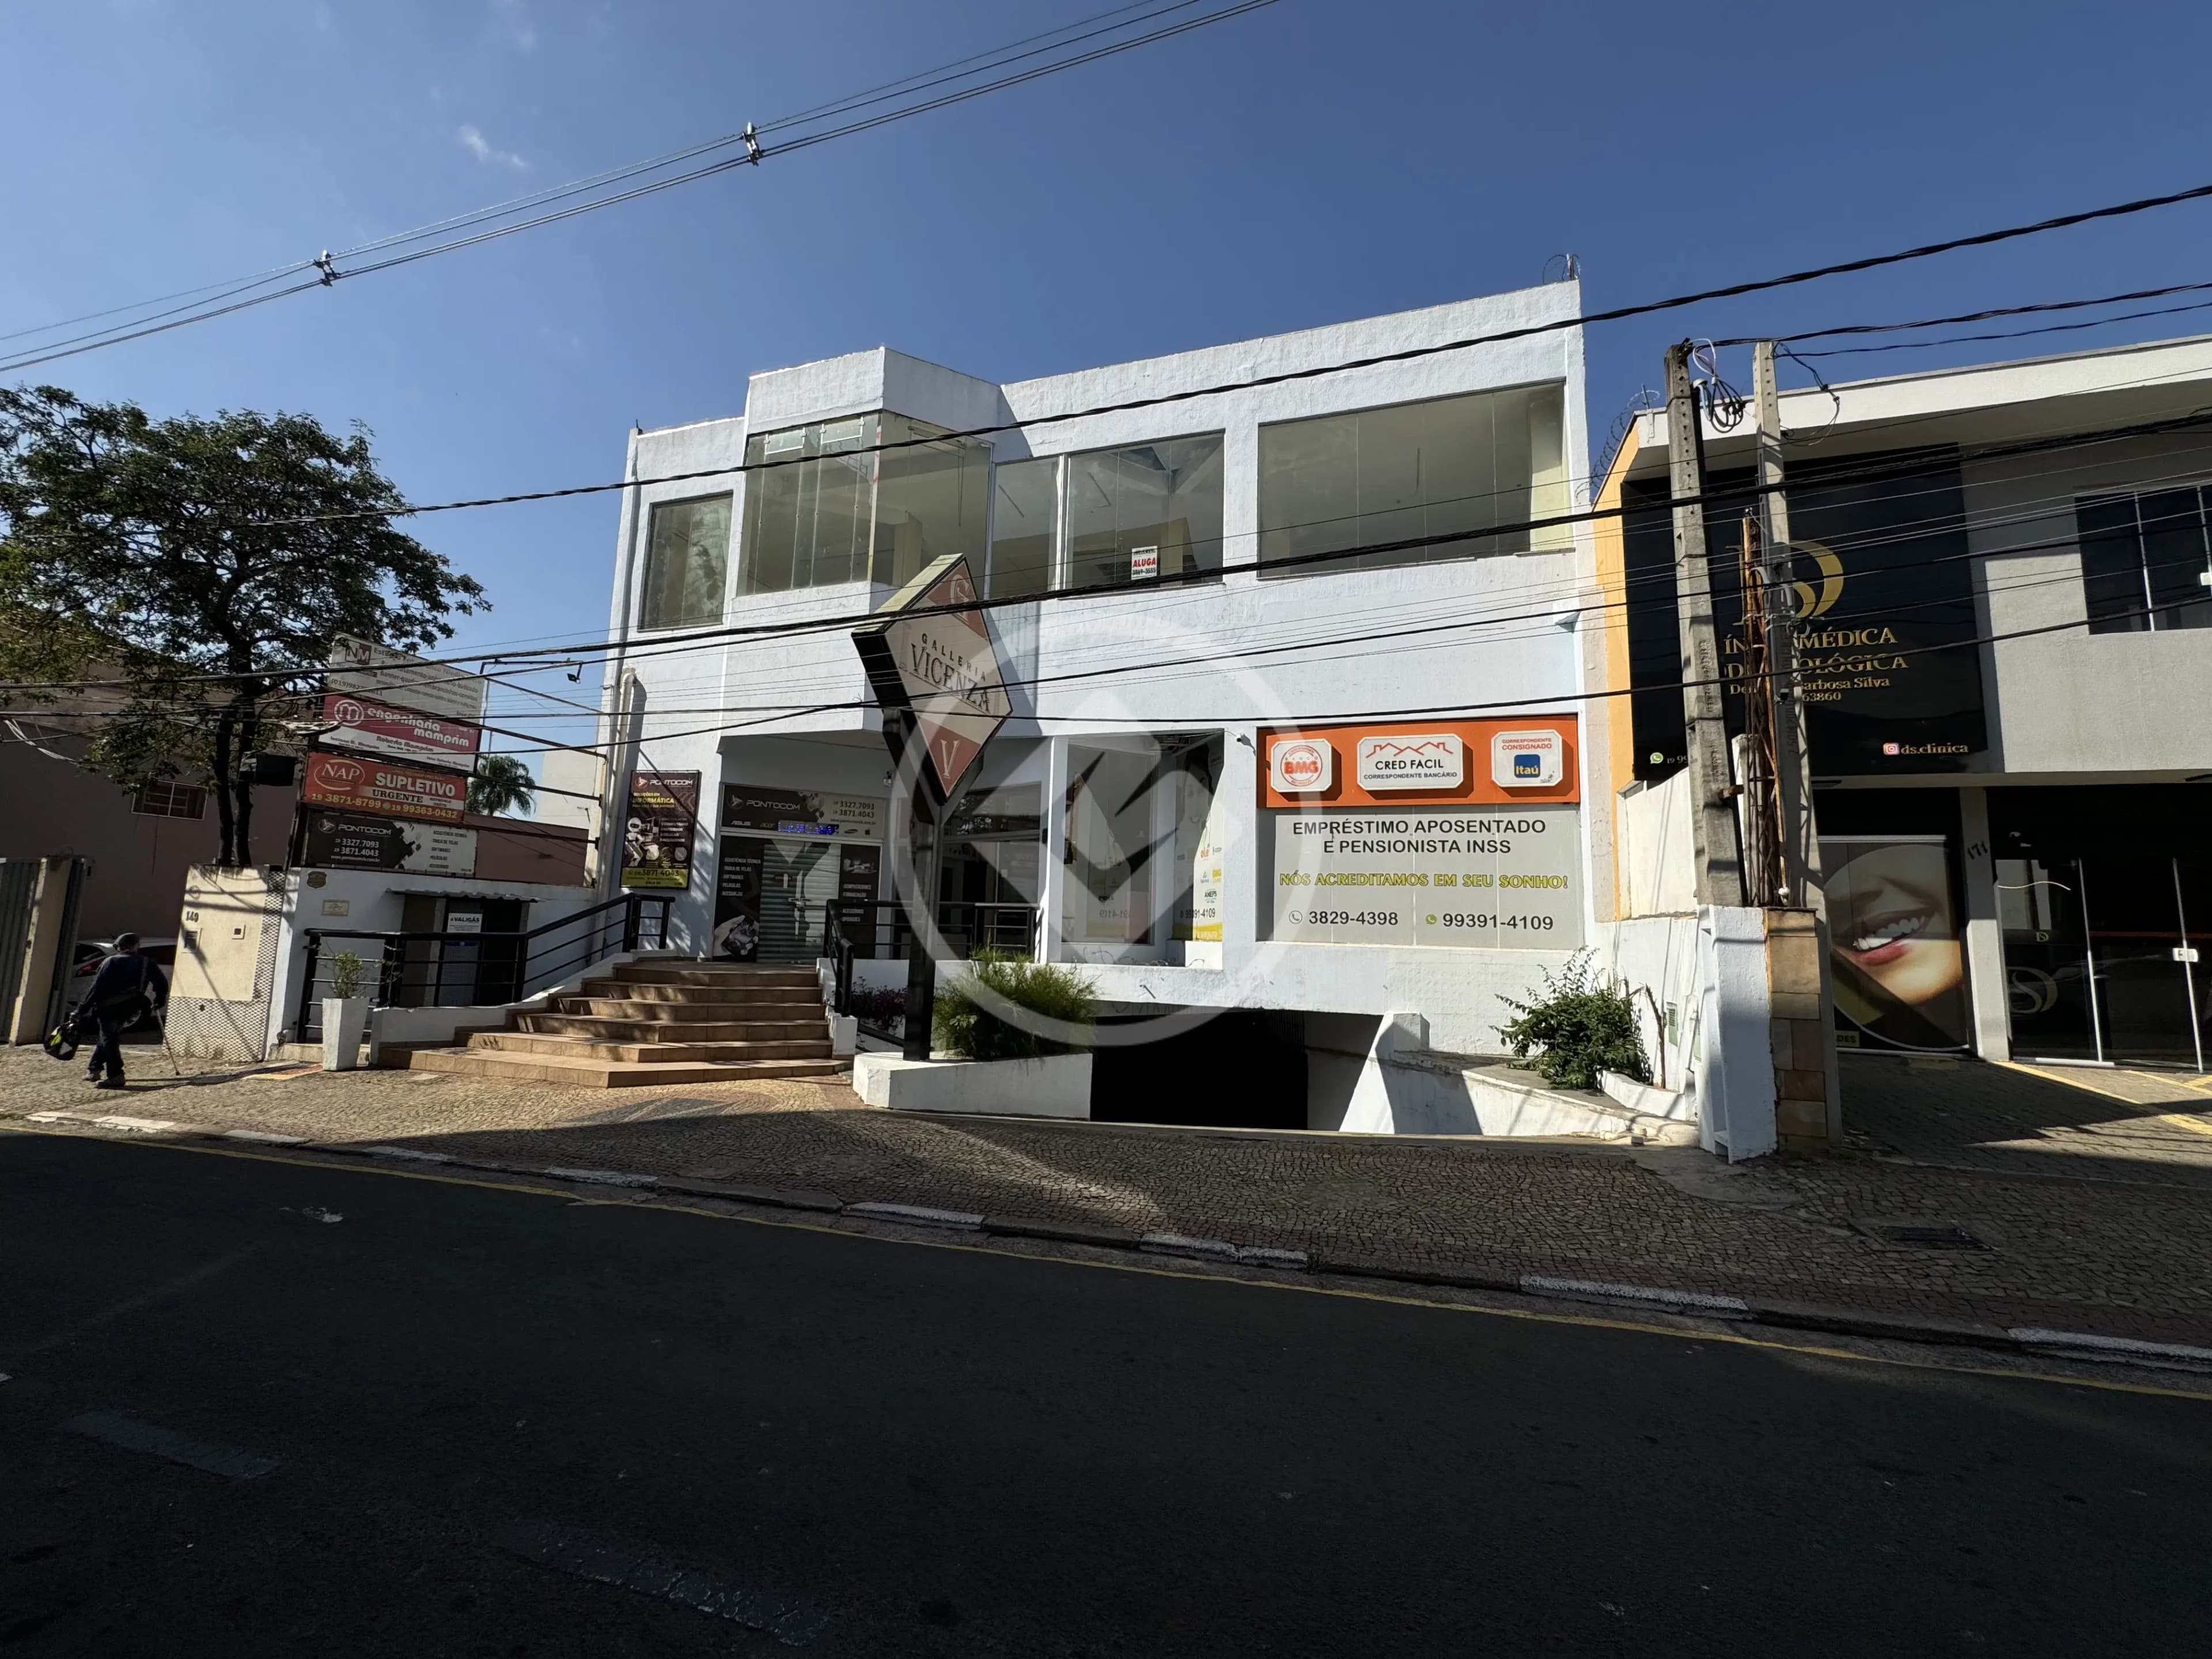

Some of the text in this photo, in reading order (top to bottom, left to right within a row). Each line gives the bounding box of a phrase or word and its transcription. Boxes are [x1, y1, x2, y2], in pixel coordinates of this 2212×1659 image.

[1133, 558, 1156, 567] ALUGA
[1799, 627, 1898, 649] MÉDICA
[922, 633, 986, 682] GALLERIA
[911, 643, 991, 714] VICENZA
[1854, 676, 1890, 688] Silva
[368, 708, 440, 731] engenharia
[414, 727, 469, 747] mamprim
[1901, 743, 1968, 754] ds.clinica
[940, 739, 960, 779] V
[1375, 759, 1444, 770] CRED FACIL
[321, 764, 360, 780] NAP
[1285, 761, 1318, 774] BMG
[1516, 764, 1539, 774] Itaú
[376, 772, 455, 797] SUPLETIVO
[372, 789, 423, 803] URGENTE
[325, 794, 381, 808] 3871-8799
[403, 804, 457, 819] 99363-0432
[746, 800, 800, 810] PONTOCOM
[840, 801, 874, 810] 3327.7093
[839, 809, 874, 818] 3871.4043
[338, 824, 392, 835] PONTOCOM
[1293, 819, 1546, 835] EMPRÉSTIMO APOSENTADO
[342, 838, 380, 849] 3327.7093
[1324, 839, 1511, 853] E PENSIONISTA INSS
[1967, 841, 1987, 859] 171
[340, 847, 378, 857] 3871.4043
[1279, 870, 1569, 889] NÓS ACREDITAMOS EM SEU SONHO!
[185, 911, 199, 922] 149
[1308, 911, 1554, 930] 3829-4398 99391-4109
